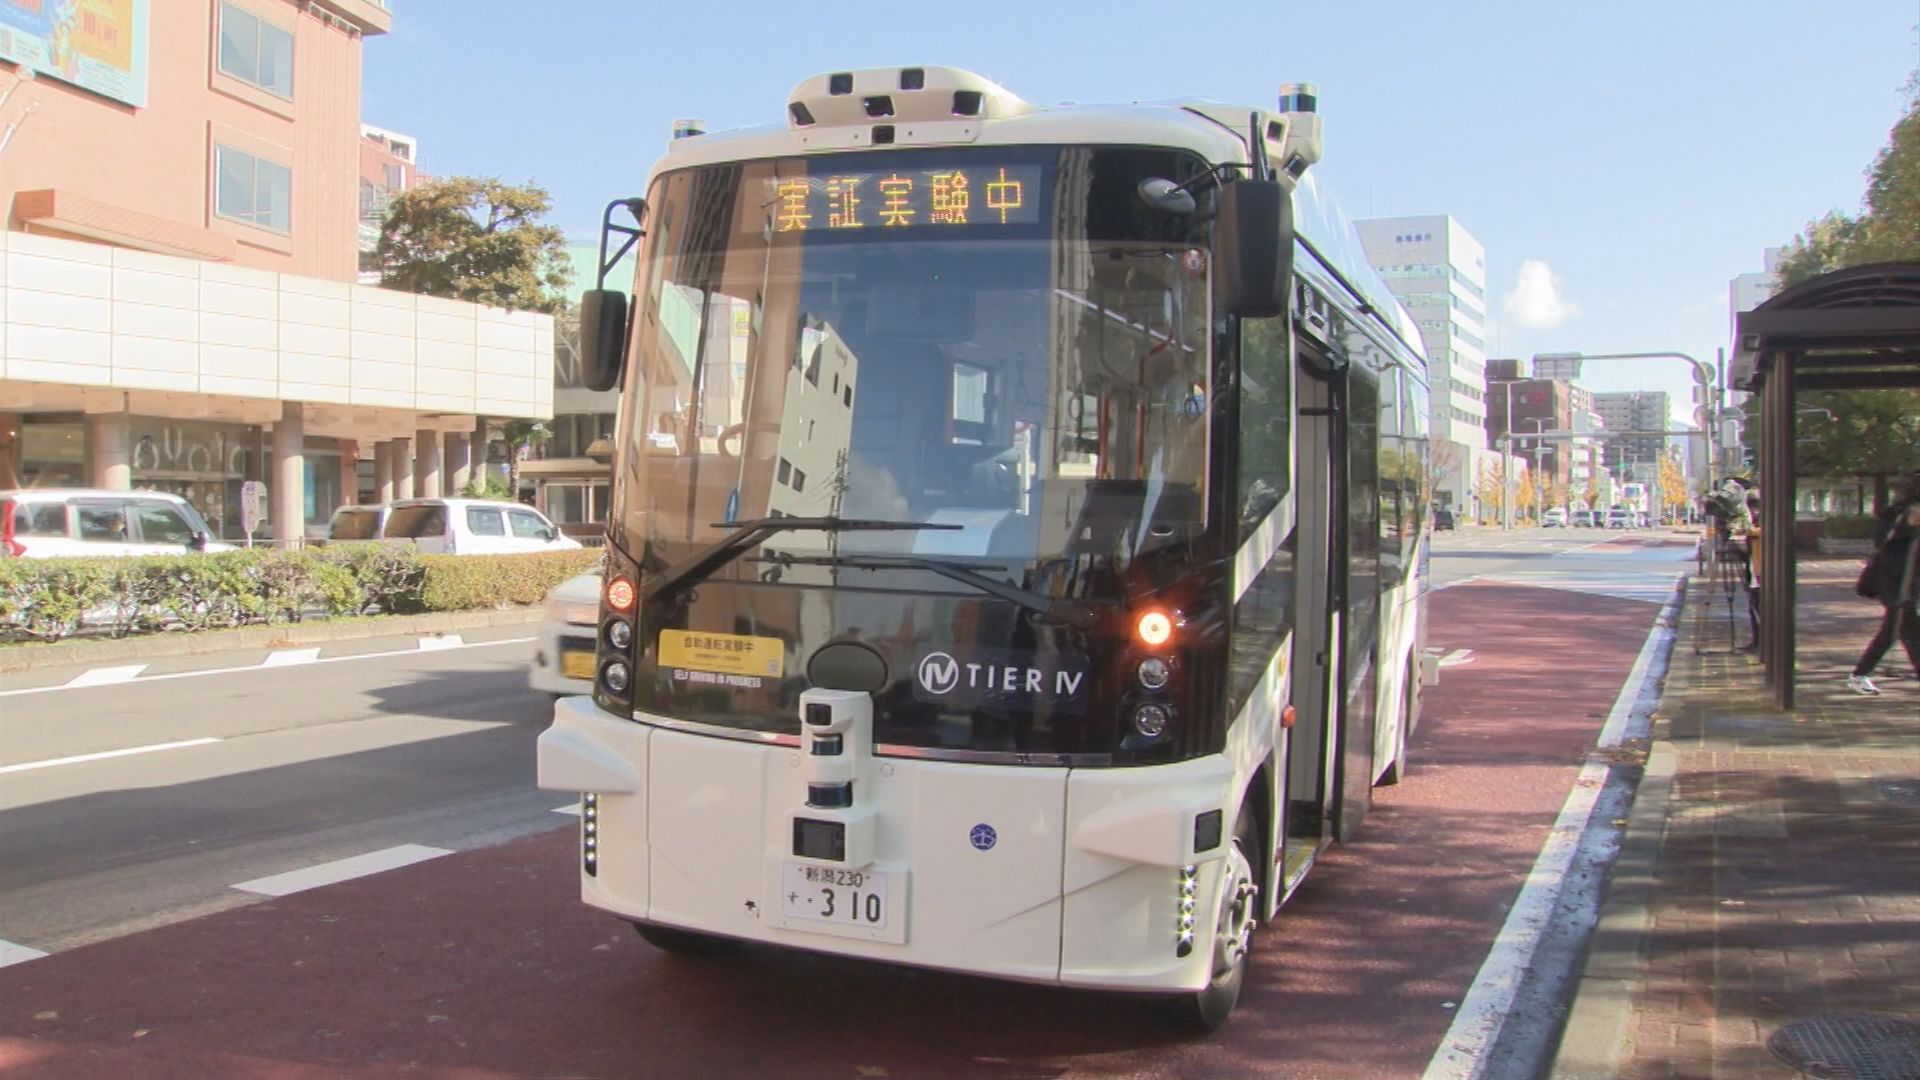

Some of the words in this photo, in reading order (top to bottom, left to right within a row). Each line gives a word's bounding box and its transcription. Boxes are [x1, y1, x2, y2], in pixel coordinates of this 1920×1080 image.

[777, 167, 1022, 232] 実証実験中
[965, 662, 1043, 693] TIER
